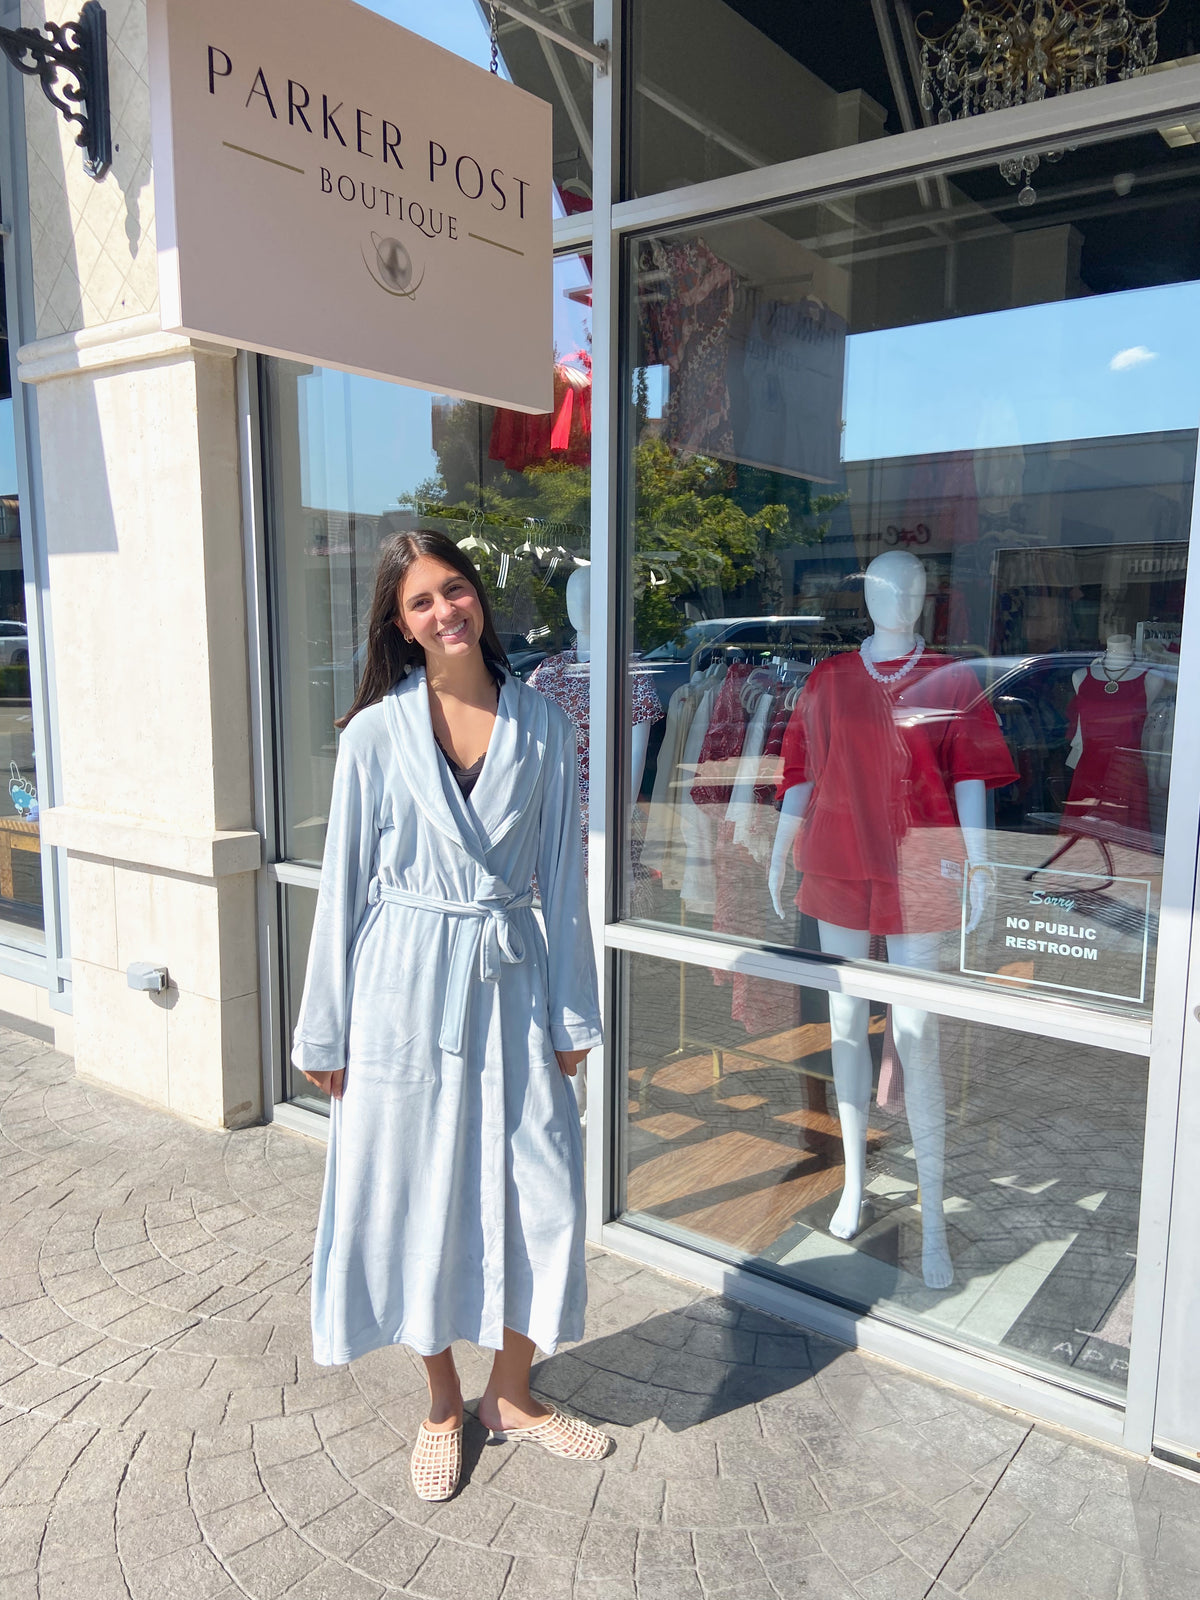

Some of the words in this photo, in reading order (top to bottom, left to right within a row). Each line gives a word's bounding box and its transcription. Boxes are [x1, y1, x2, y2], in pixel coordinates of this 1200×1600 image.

[207, 45, 404, 170] PARKER
[429, 140, 531, 219] POST
[319, 167, 459, 241] BOUTIQUE
[1029, 890, 1076, 912] Sorry
[1006, 916, 1030, 930] NO
[1034, 920, 1097, 940] PUBLIC
[1005, 935, 1098, 961] RESTROOM
